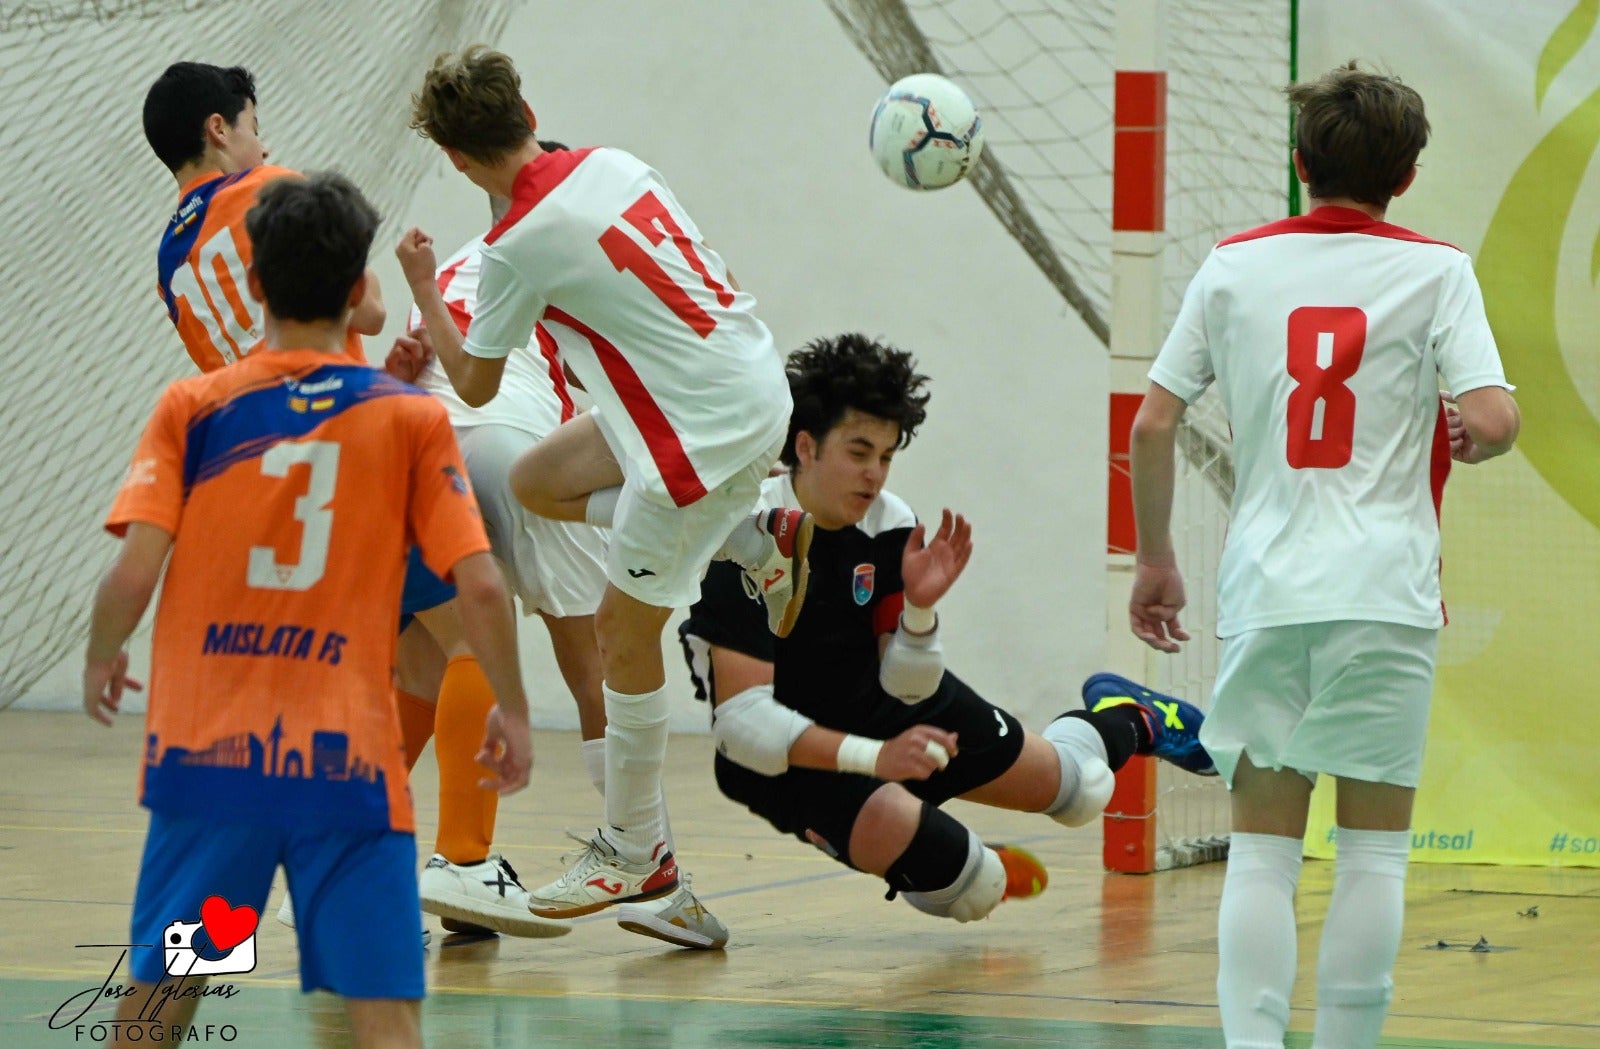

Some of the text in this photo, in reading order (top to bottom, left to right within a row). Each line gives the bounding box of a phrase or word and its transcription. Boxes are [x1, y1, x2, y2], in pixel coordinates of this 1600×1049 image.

[170, 225, 266, 366] 10
[597, 190, 735, 339] 17
[1286, 306, 1367, 470] 8
[246, 440, 342, 592] 3
[202, 622, 348, 666] MISLATA FS
